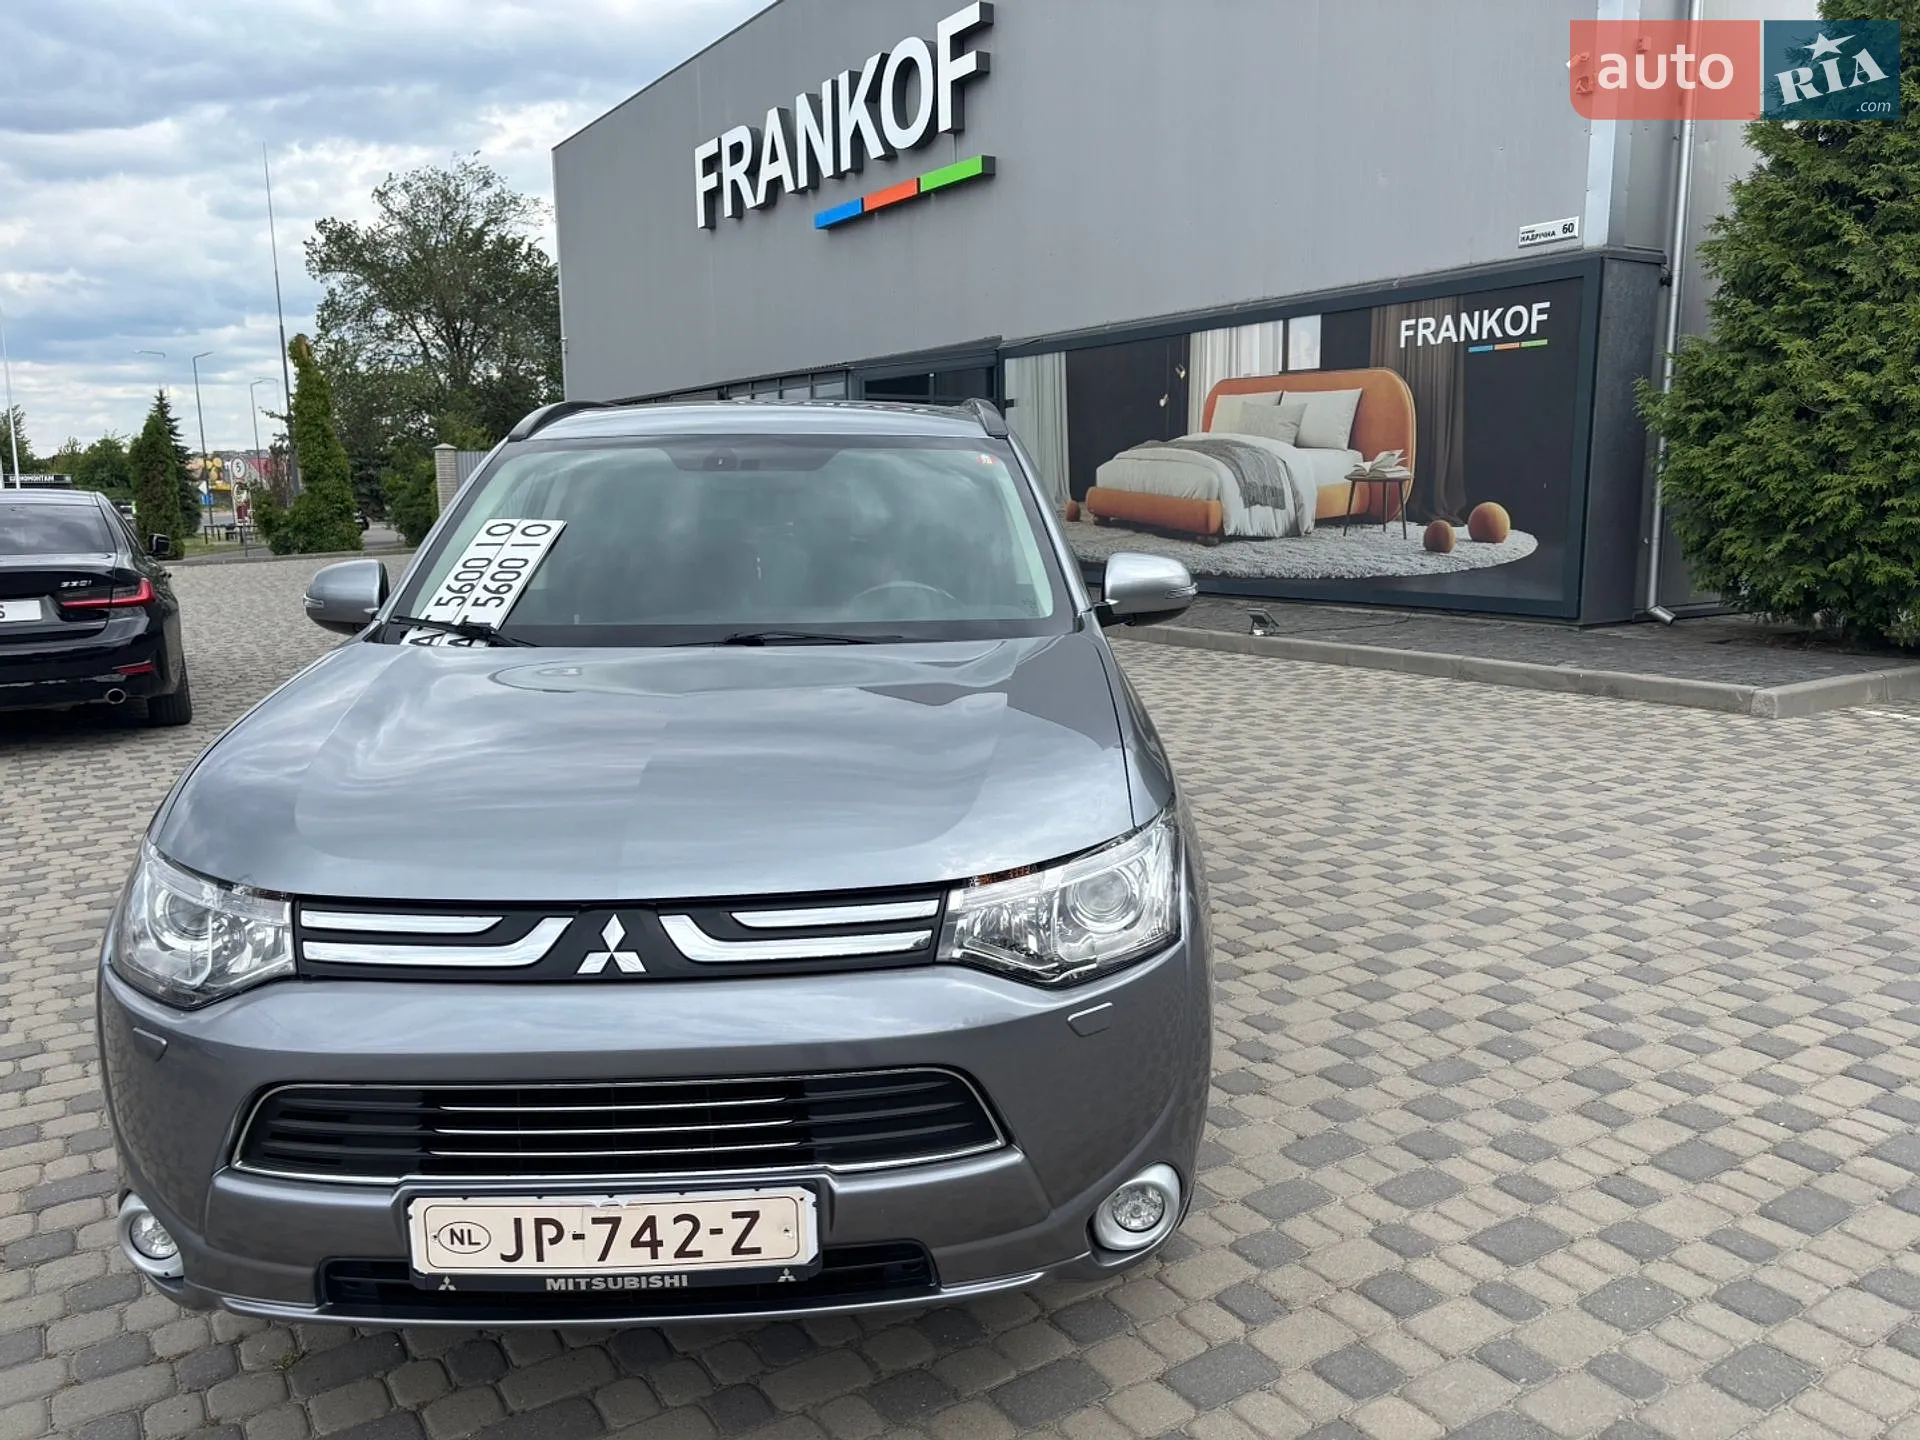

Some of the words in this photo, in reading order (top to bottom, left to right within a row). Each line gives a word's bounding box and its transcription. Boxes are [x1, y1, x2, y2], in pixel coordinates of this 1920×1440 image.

[695, 1, 992, 229] FRANKOF
[1562, 222, 1575, 234] 60
[1400, 301, 1550, 348] FRANKOF
[434, 557, 493, 607] 5600
[471, 557, 529, 608] 5600
[449, 1228, 481, 1246] NL
[499, 1210, 762, 1262] JP-742-Z
[545, 1274, 688, 1291] MITSUBISHI
